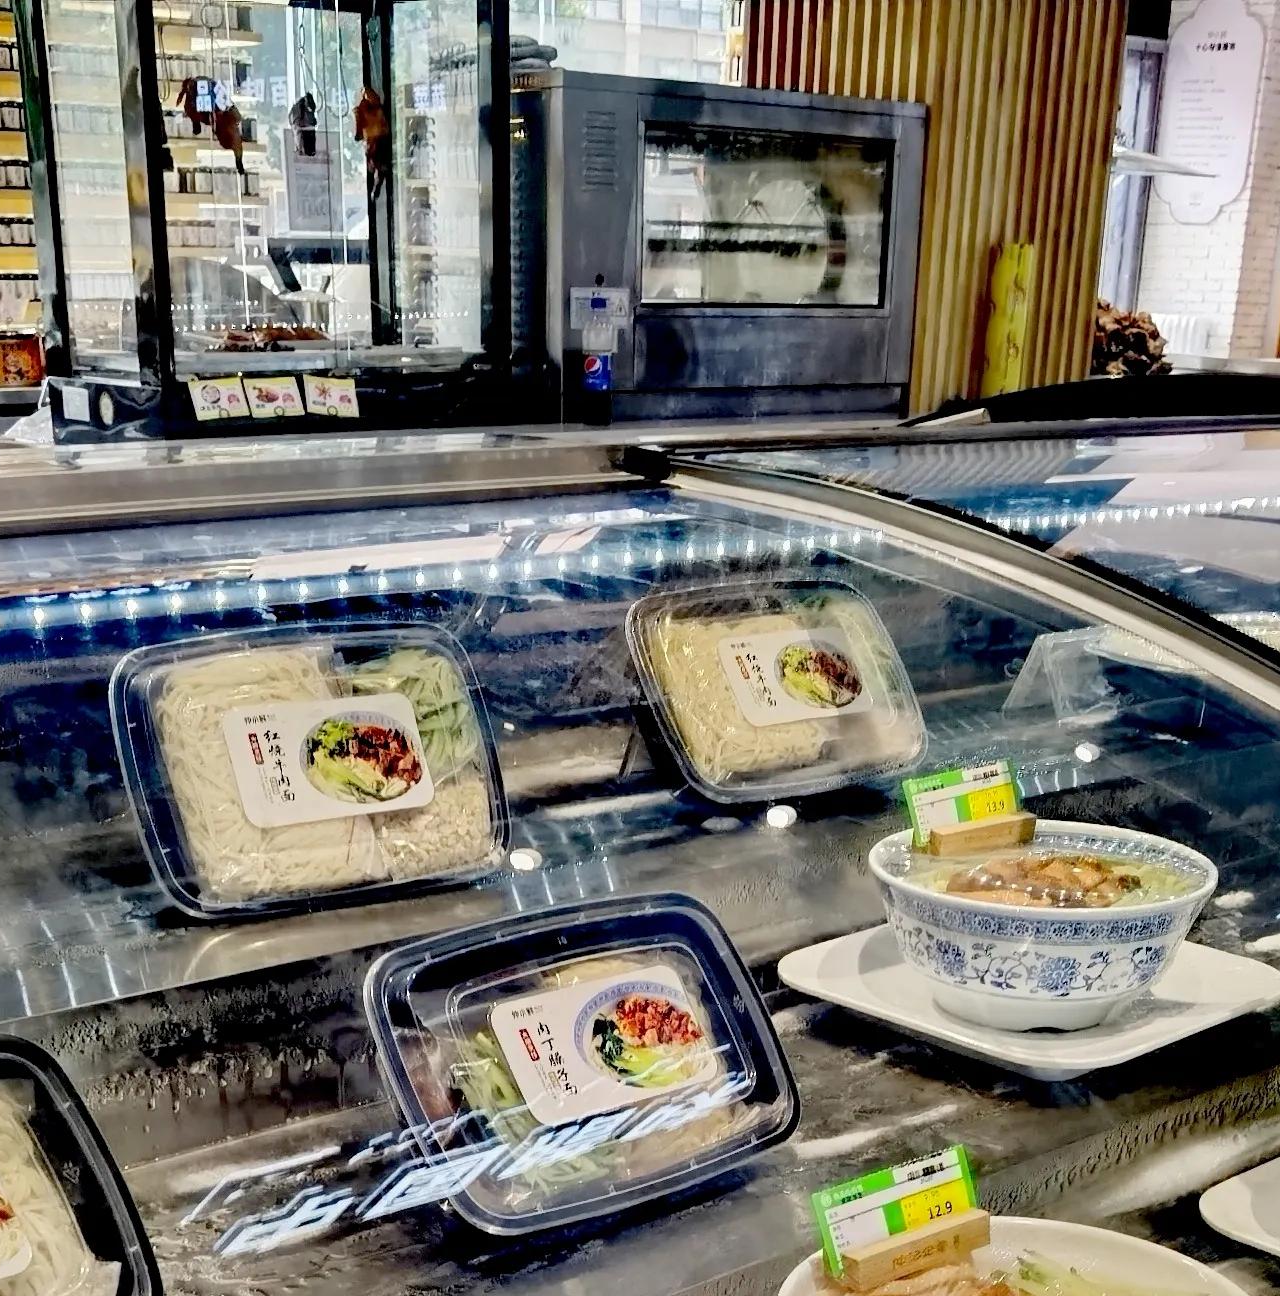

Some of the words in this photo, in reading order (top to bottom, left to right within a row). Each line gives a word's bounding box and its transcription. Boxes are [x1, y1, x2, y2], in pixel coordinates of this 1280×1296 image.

[263, 730, 296, 801] 红烧牛肉面
[928, 1201, 954, 1221] 12.9
